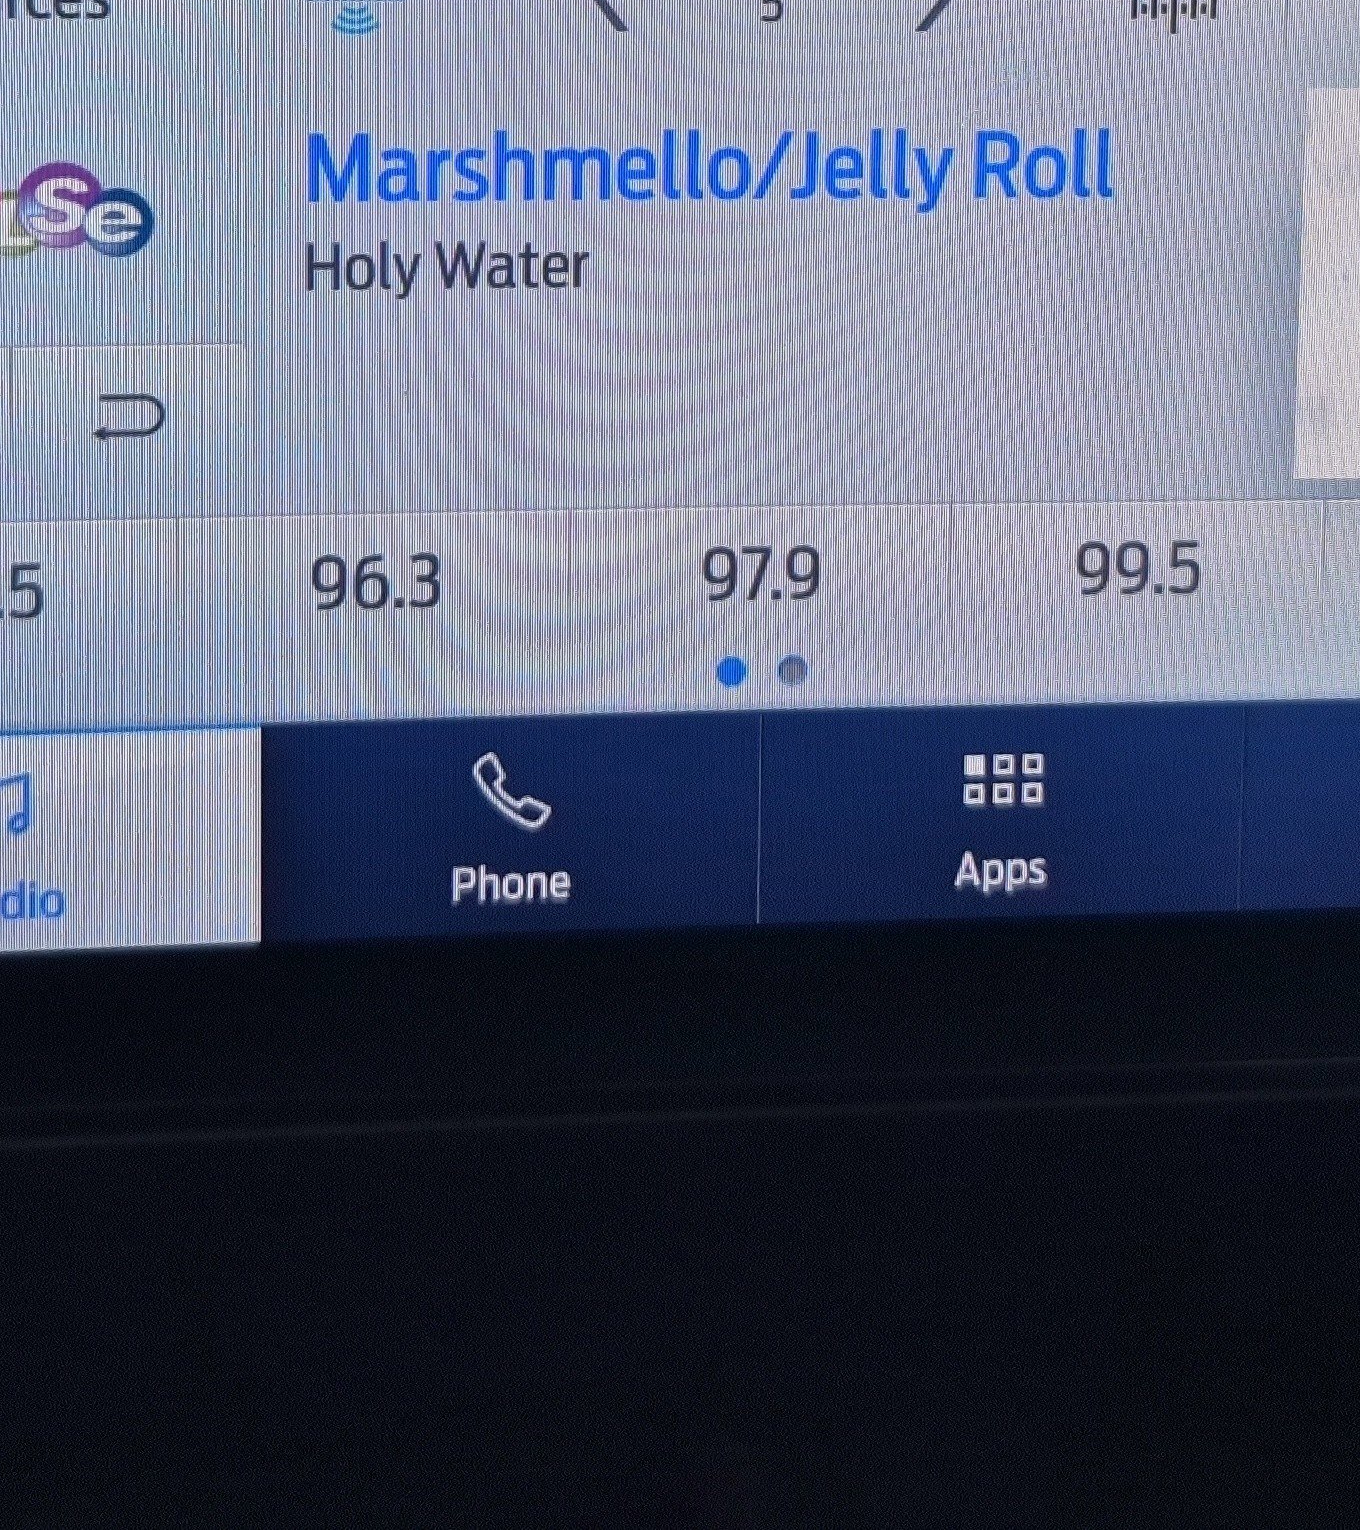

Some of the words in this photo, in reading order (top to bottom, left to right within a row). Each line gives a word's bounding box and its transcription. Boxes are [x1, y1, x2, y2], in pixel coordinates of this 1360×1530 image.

[307, 127, 955, 214] Marshmello/Jelly
[972, 127, 1114, 200] Roll
[307, 242, 420, 300] Holy
[436, 242, 591, 293] Water
[310, 553, 443, 612] 96.3
[701, 545, 822, 602] 97.9
[1075, 541, 1202, 596] 99.5
[451, 866, 572, 905] Phone
[954, 852, 1048, 894] Apps
